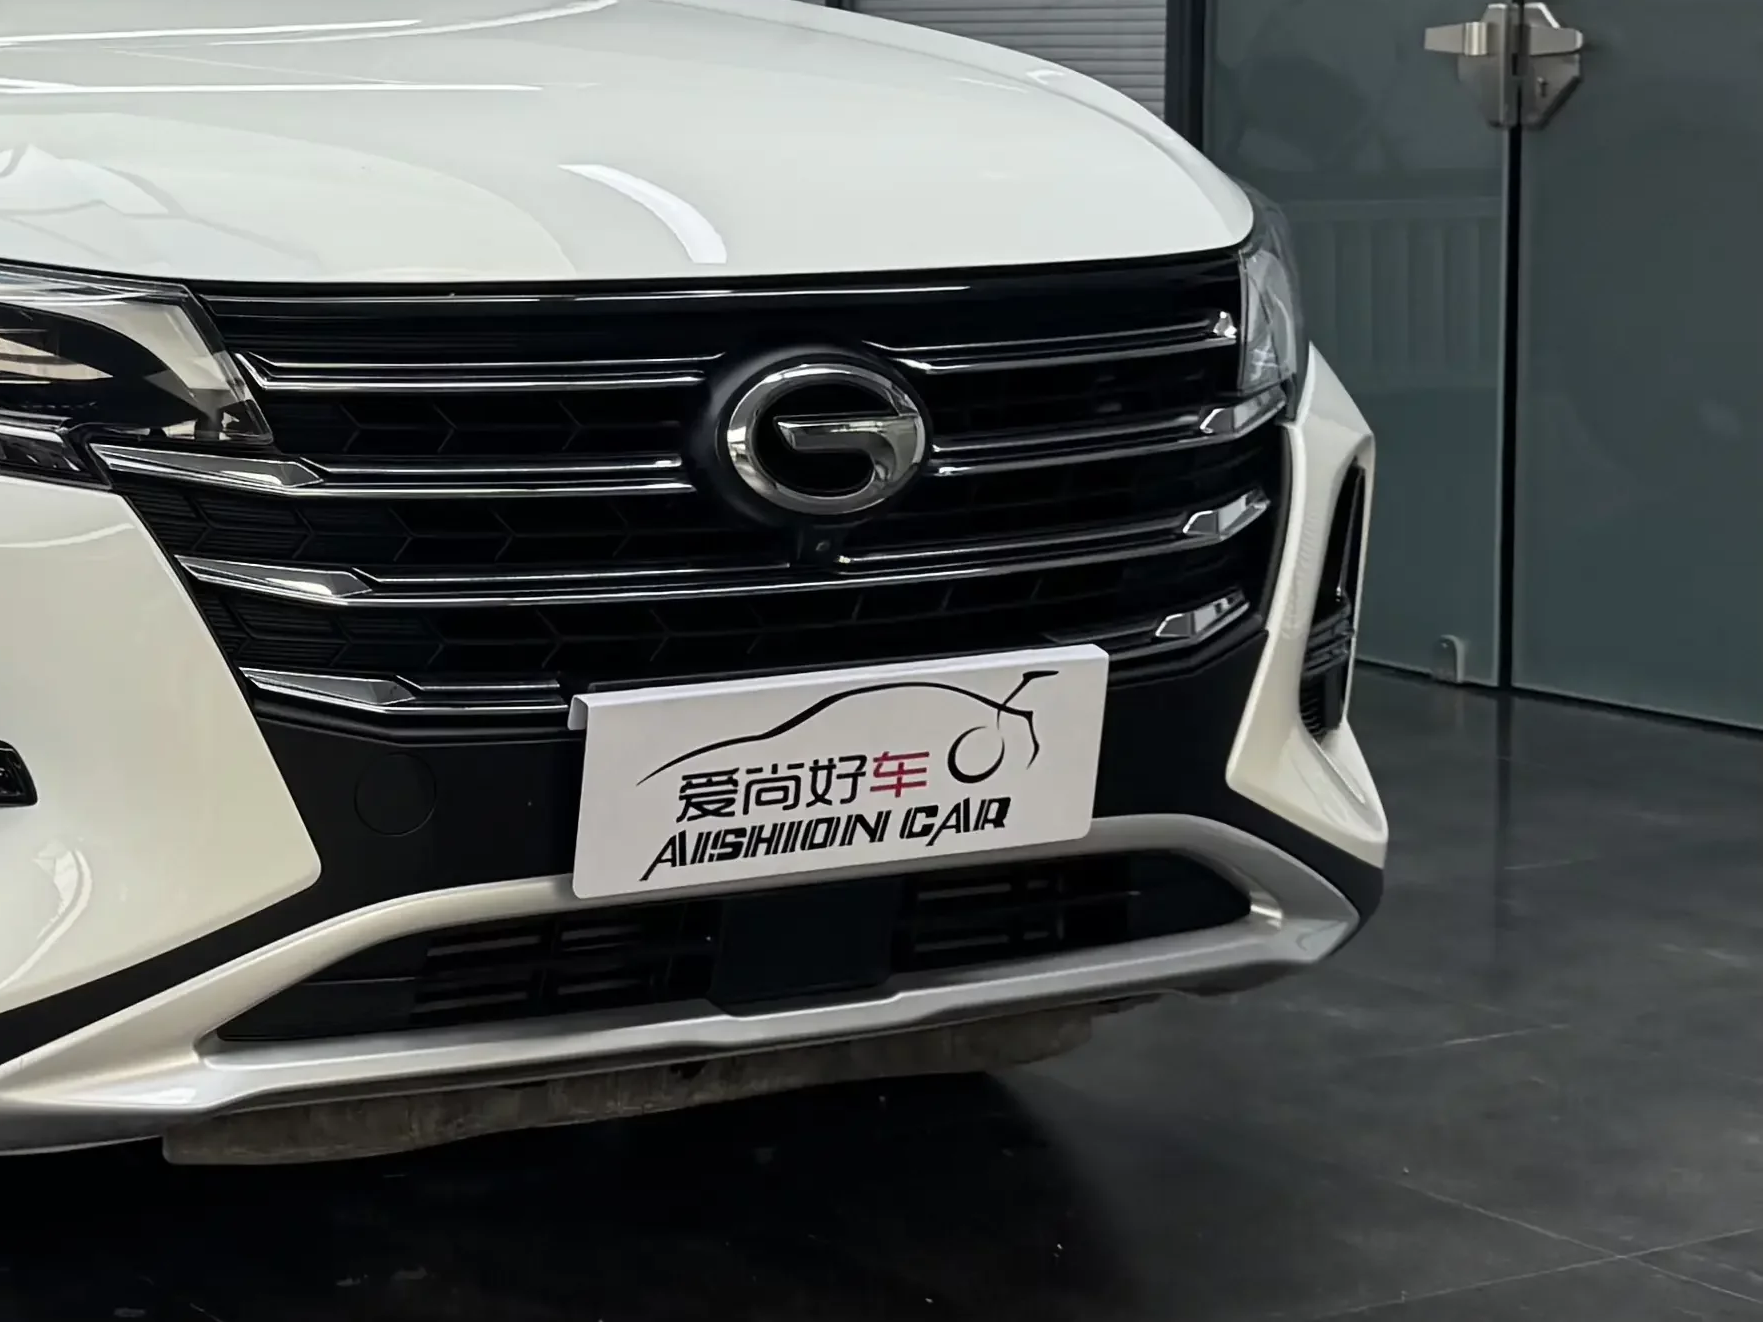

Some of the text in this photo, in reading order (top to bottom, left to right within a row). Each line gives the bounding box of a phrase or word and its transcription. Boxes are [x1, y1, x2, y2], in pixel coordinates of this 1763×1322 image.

[675, 750, 930, 825] 爱尚好车
[640, 797, 1013, 882] AISHION CAR
